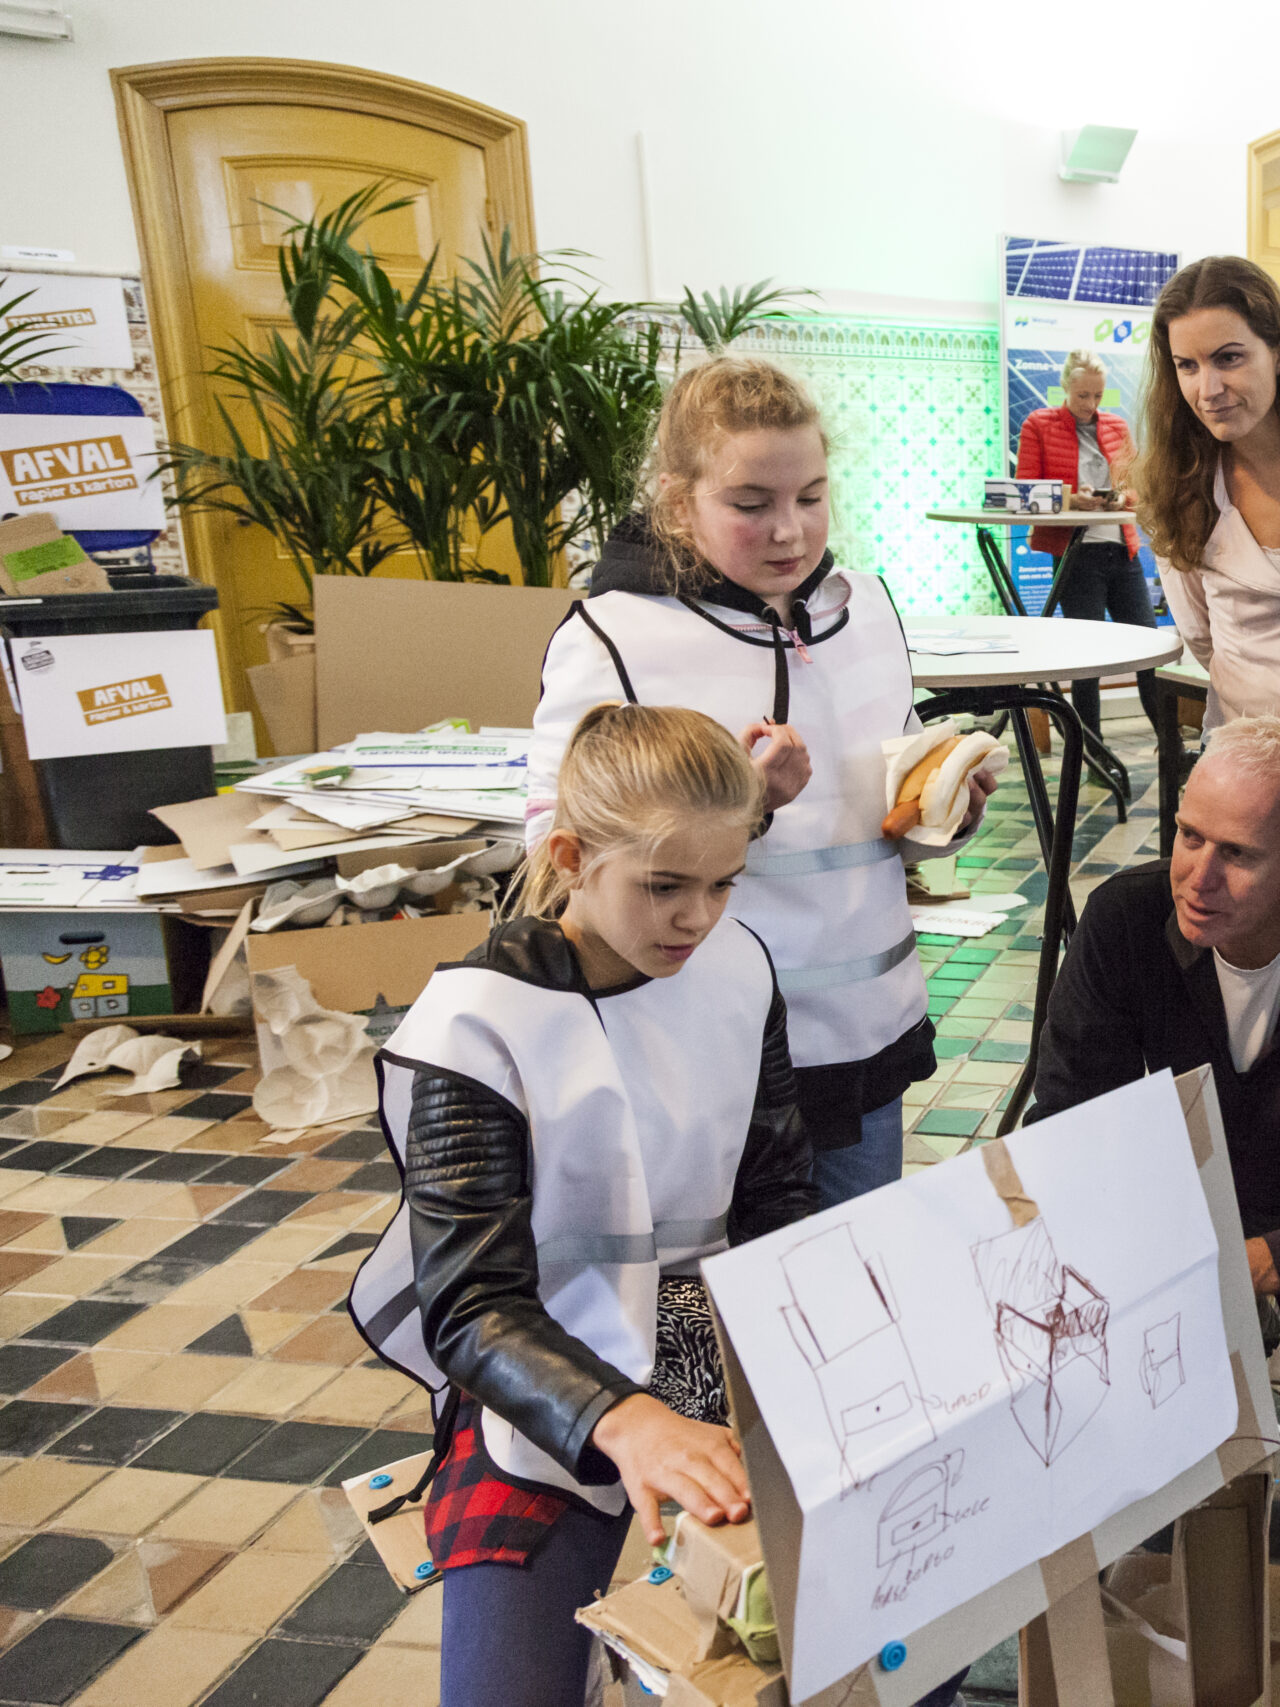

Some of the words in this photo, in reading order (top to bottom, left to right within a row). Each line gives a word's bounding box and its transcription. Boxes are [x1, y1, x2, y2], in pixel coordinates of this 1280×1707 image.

[13, 442, 127, 482] AFVAL
[69, 483, 81, 495] &
[83, 477, 134, 493] karton
[93, 680, 157, 707] AFVAL
